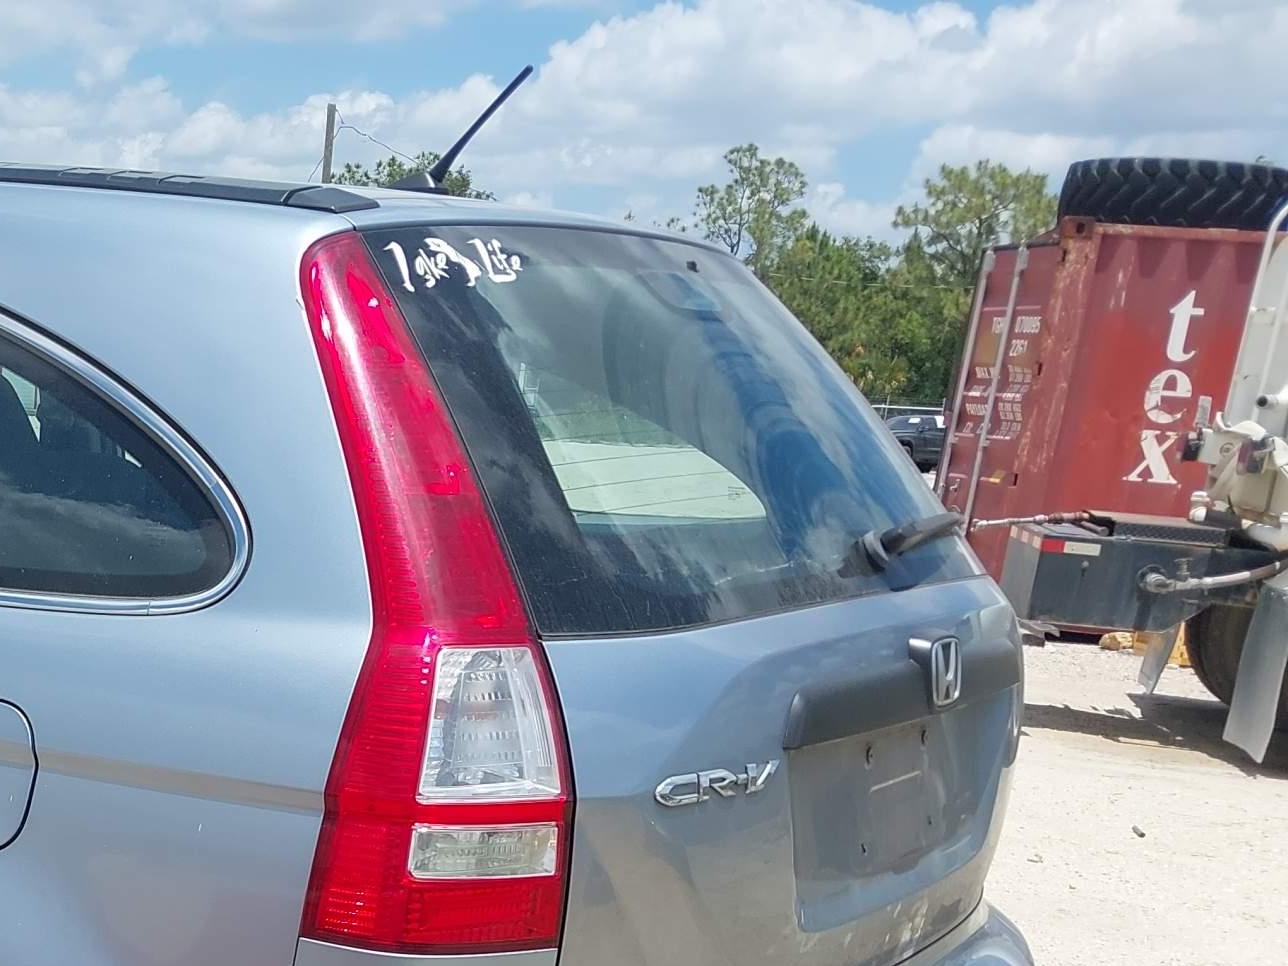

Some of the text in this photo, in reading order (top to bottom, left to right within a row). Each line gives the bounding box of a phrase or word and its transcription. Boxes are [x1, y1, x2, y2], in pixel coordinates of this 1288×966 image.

[466, 238, 524, 283] Life
[1122, 289, 1205, 485] tex
[655, 760, 780, 807] CR-V
